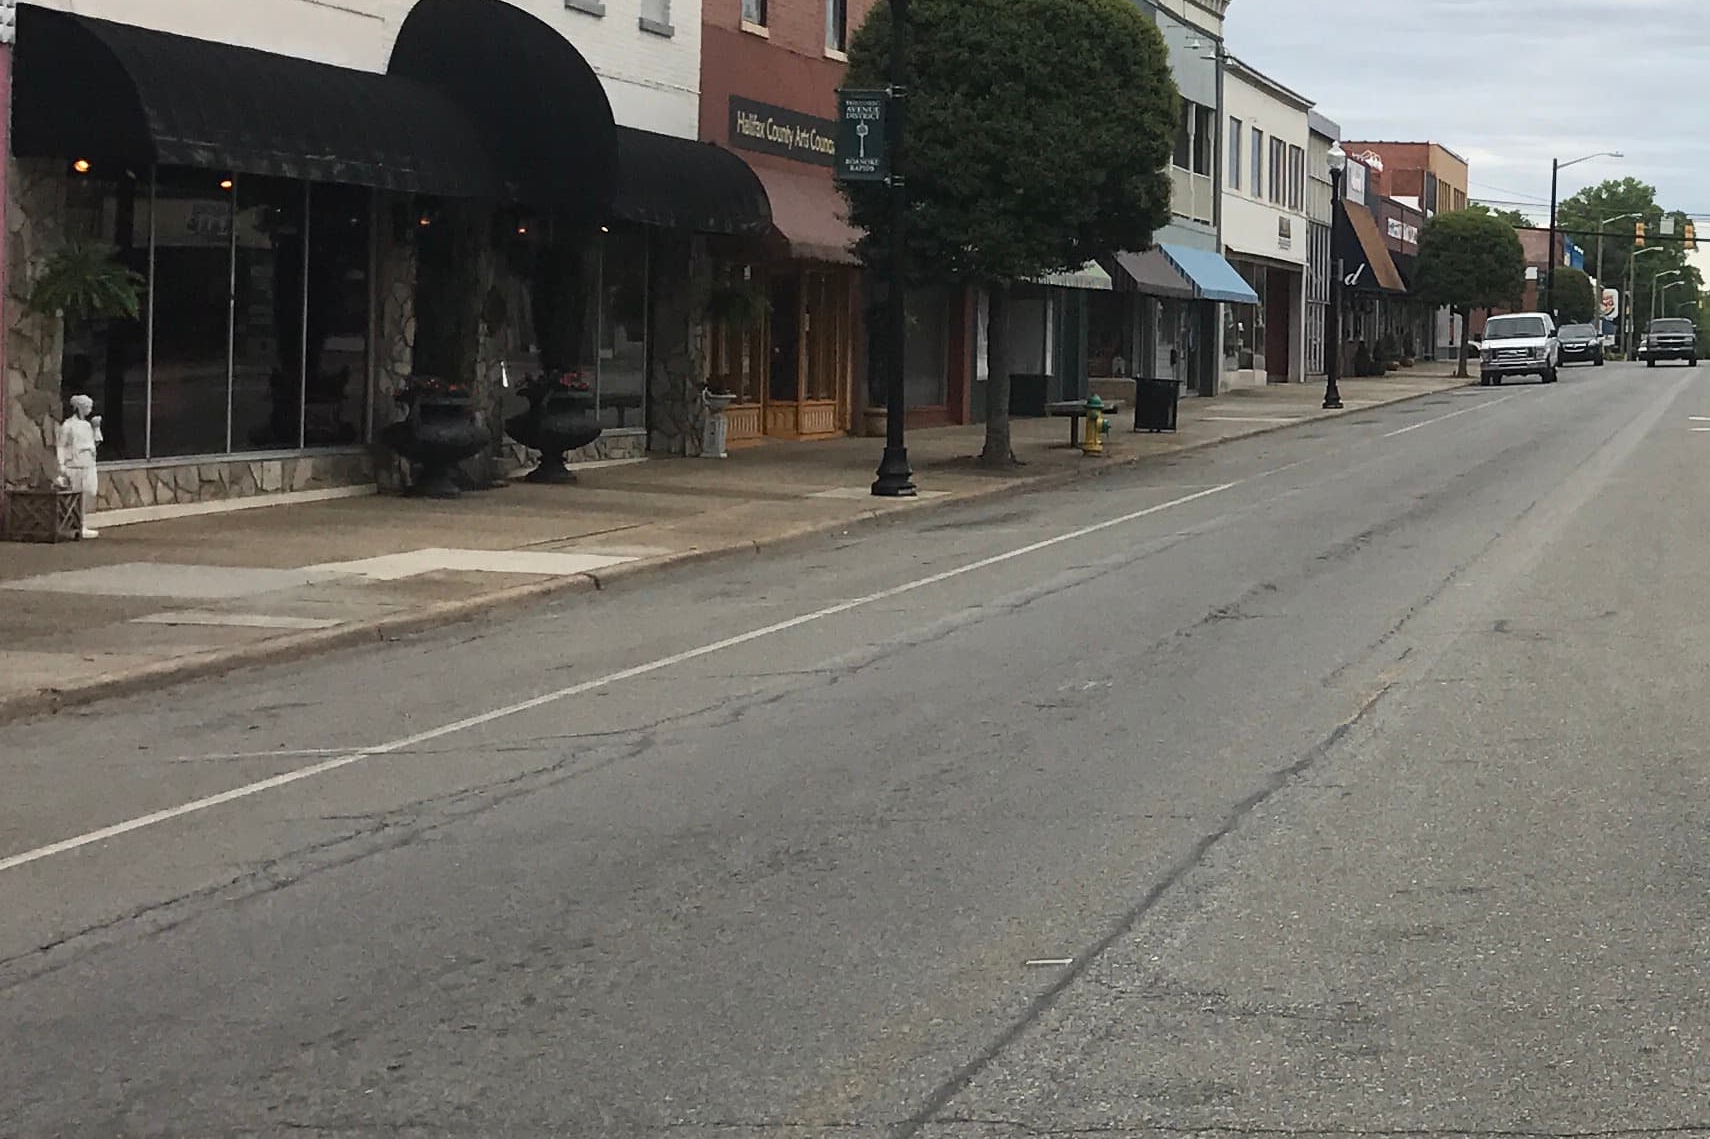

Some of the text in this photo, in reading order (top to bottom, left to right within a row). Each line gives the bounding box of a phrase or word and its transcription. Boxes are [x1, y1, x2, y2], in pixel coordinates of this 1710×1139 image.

[846, 112, 880, 120] DISTRICT
[737, 110, 766, 139] Halifax
[767, 117, 794, 150] County
[794, 125, 809, 149] Arts
